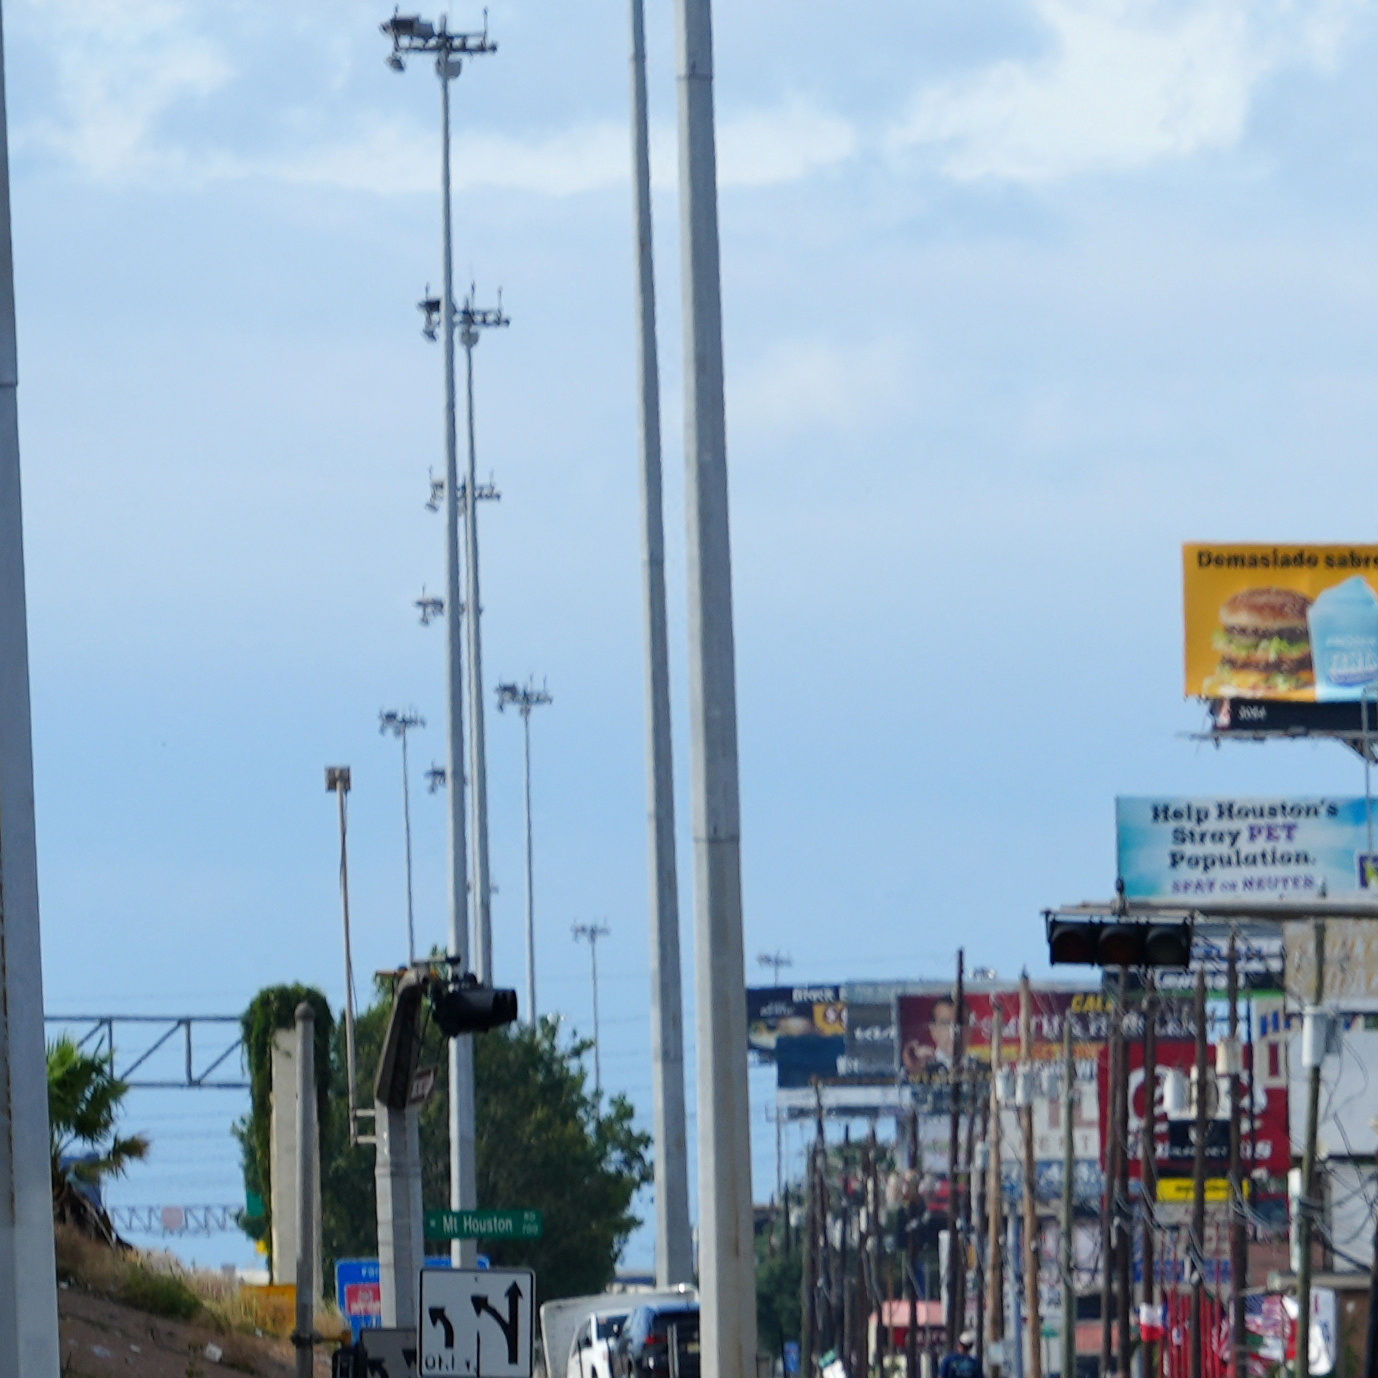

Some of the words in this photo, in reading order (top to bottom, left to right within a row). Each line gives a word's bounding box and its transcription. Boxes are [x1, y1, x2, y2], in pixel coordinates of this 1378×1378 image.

[1198, 549, 1318, 571] Demasiado
[1152, 803, 1209, 824] Help
[1217, 801, 1339, 820] Houston's
[1171, 826, 1241, 847] Stray
[1247, 823, 1299, 843] PET
[1168, 848, 1316, 872] Population.
[443, 1215, 458, 1234] Mt
[463, 1215, 513, 1233] Houston
